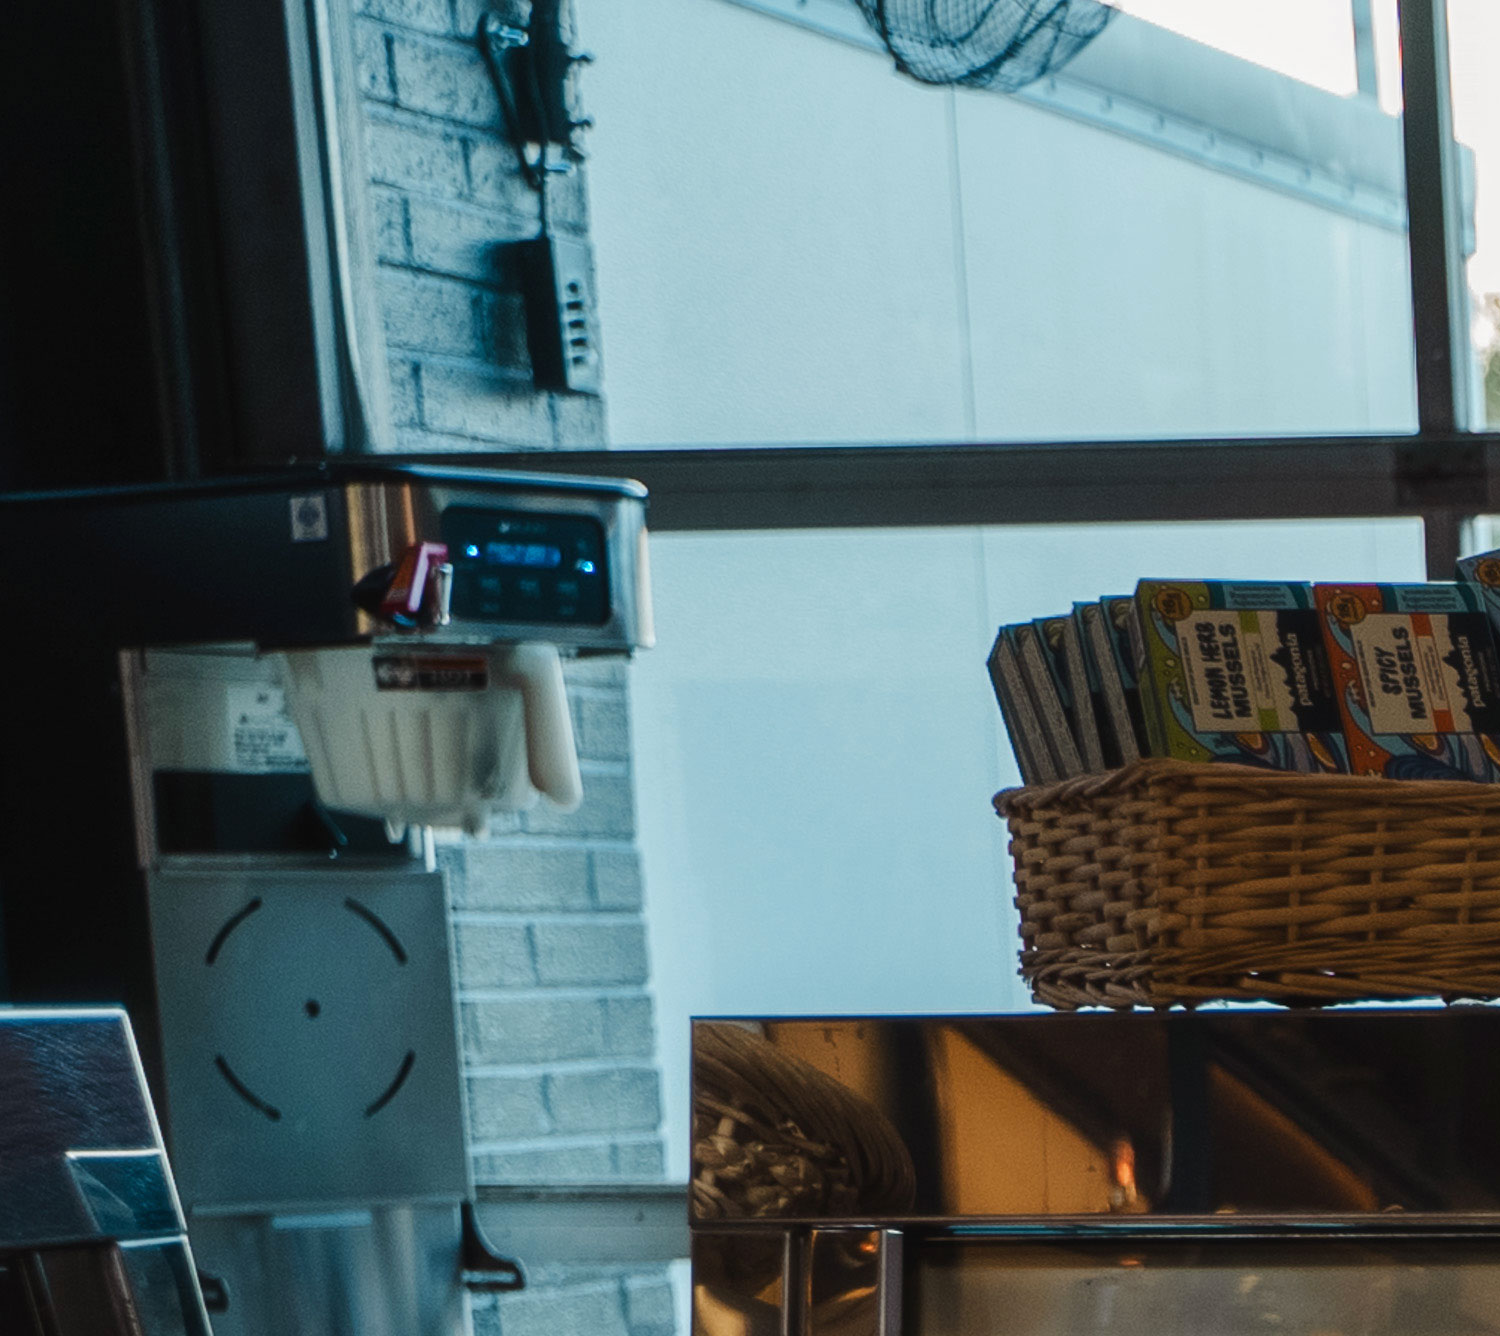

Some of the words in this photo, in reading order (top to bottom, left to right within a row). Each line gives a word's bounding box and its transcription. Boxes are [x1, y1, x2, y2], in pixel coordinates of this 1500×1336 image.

[1195, 620, 1224, 667] HERB
[1218, 622, 1253, 719] MUSSELS
[1286, 632, 1314, 707] patagonia
[1374, 646, 1402, 696] SPICY
[1393, 626, 1427, 719] MUSSELS
[1457, 636, 1487, 708] patagonia
[1204, 667, 1234, 720] LEMON
